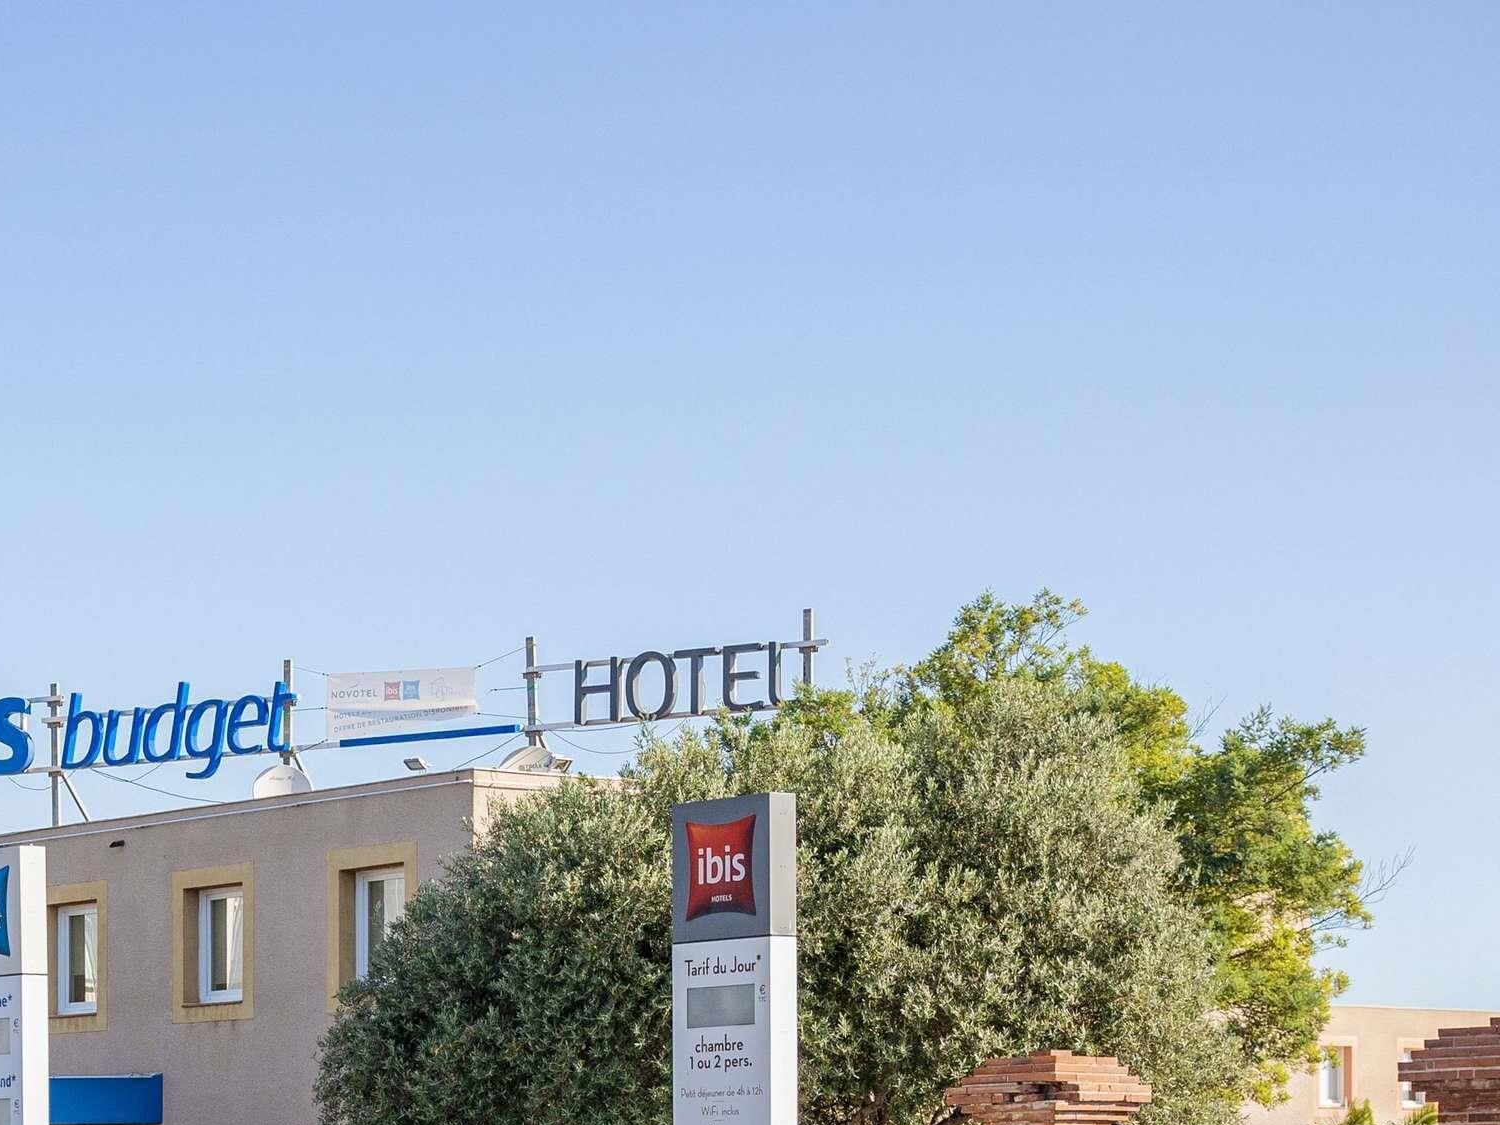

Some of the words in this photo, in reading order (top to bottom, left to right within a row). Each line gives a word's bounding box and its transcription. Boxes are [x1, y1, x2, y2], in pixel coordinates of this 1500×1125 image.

[574, 641, 785, 725] HOTEL
[331, 688, 378, 698] NOVOTEL
[61, 681, 298, 779] budget
[333, 724, 356, 733] OFFRE
[698, 845, 746, 885] ibis
[711, 894, 733, 903] HOTELS
[685, 957, 710, 977] Tarif
[713, 956, 727, 974] du
[695, 1034, 744, 1053] chambre
[689, 1056, 694, 1070] 1
[697, 1058, 711, 1069] ou
[714, 1055, 721, 1069] 2
[724, 1057, 753, 1073] pers.
[726, 1086, 736, 1097] de
[736, 1085, 745, 1096] 4h
[752, 1084, 764, 1096] 12h
[701, 1105, 719, 1116] WiFi
[721, 1105, 740, 1116] inclus
